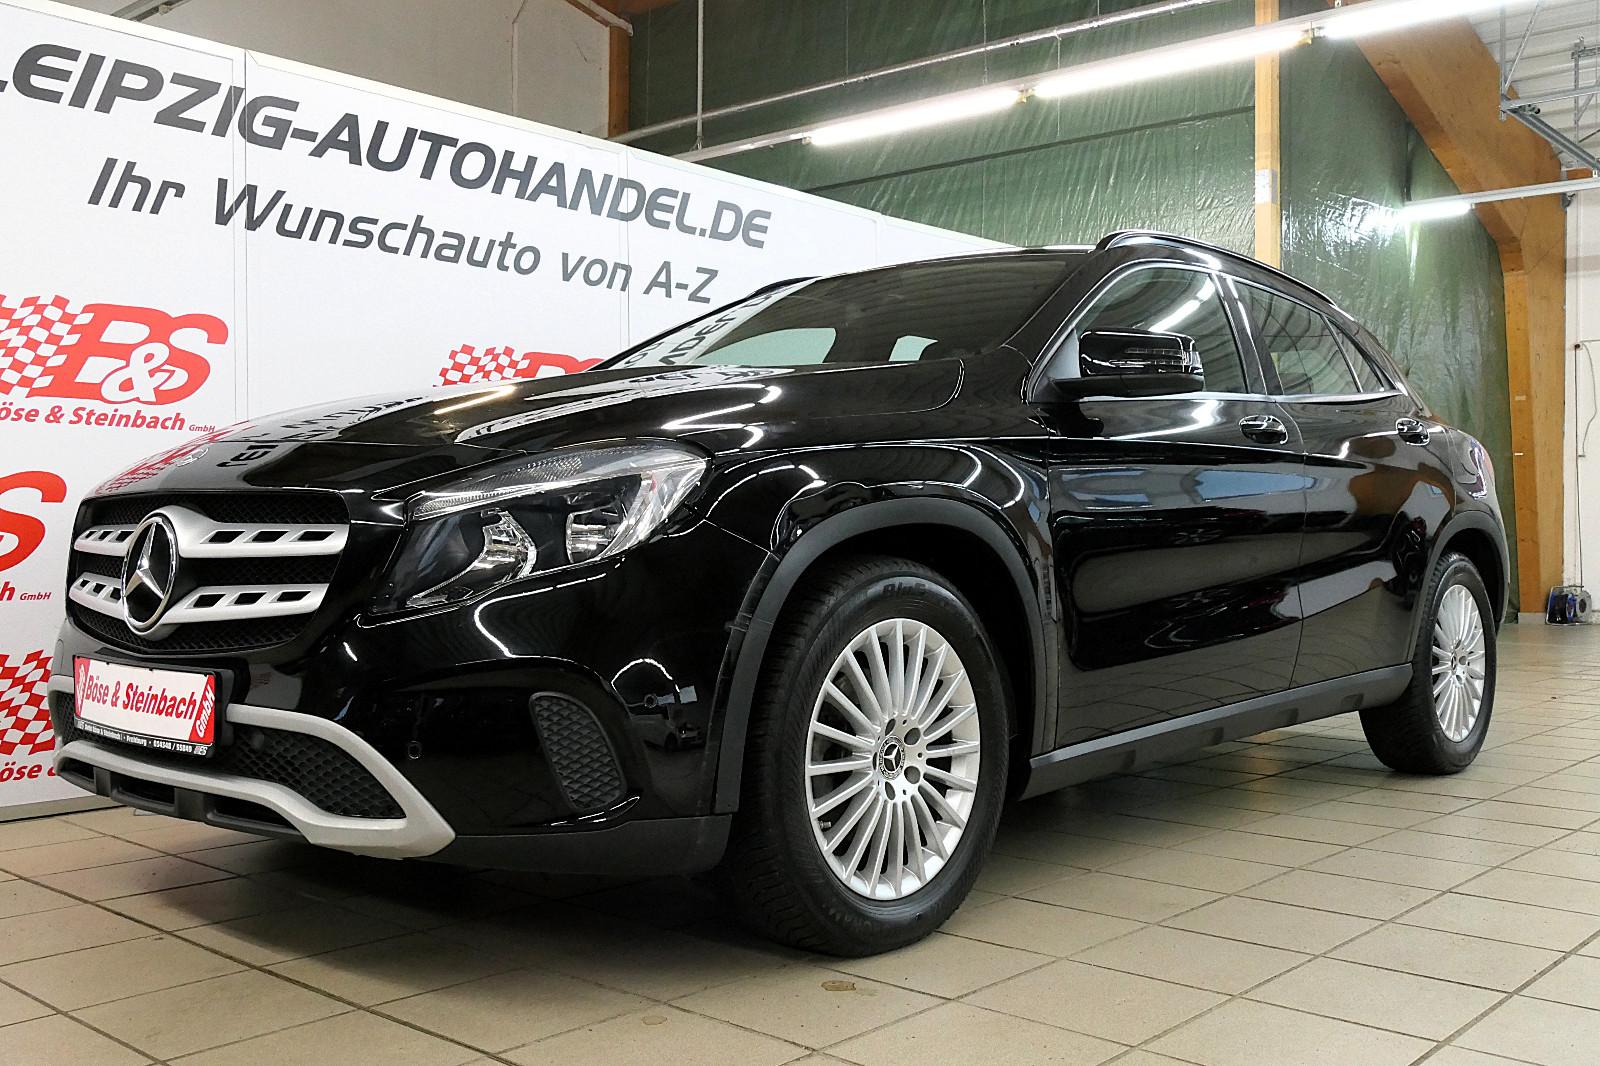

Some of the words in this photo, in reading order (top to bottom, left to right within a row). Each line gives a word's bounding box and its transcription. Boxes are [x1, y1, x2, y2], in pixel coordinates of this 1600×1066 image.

[0, 43, 772, 249] EIPZIG-AUTOHANDEL.DE
[87, 157, 186, 215] Ihr
[214, 177, 541, 275] Wunschauto
[561, 251, 633, 292] von
[643, 260, 719, 304] A-Z
[26, 303, 229, 405] B&S
[44, 405, 65, 424] &
[68, 406, 186, 431] Steinbach
[188, 423, 216, 433] GmbH
[19, 592, 52, 601] GmbH
[85, 674, 109, 705] Böse
[110, 680, 121, 707] &
[123, 682, 197, 720] Steinbach
[195, 684, 216, 738] GmbH
